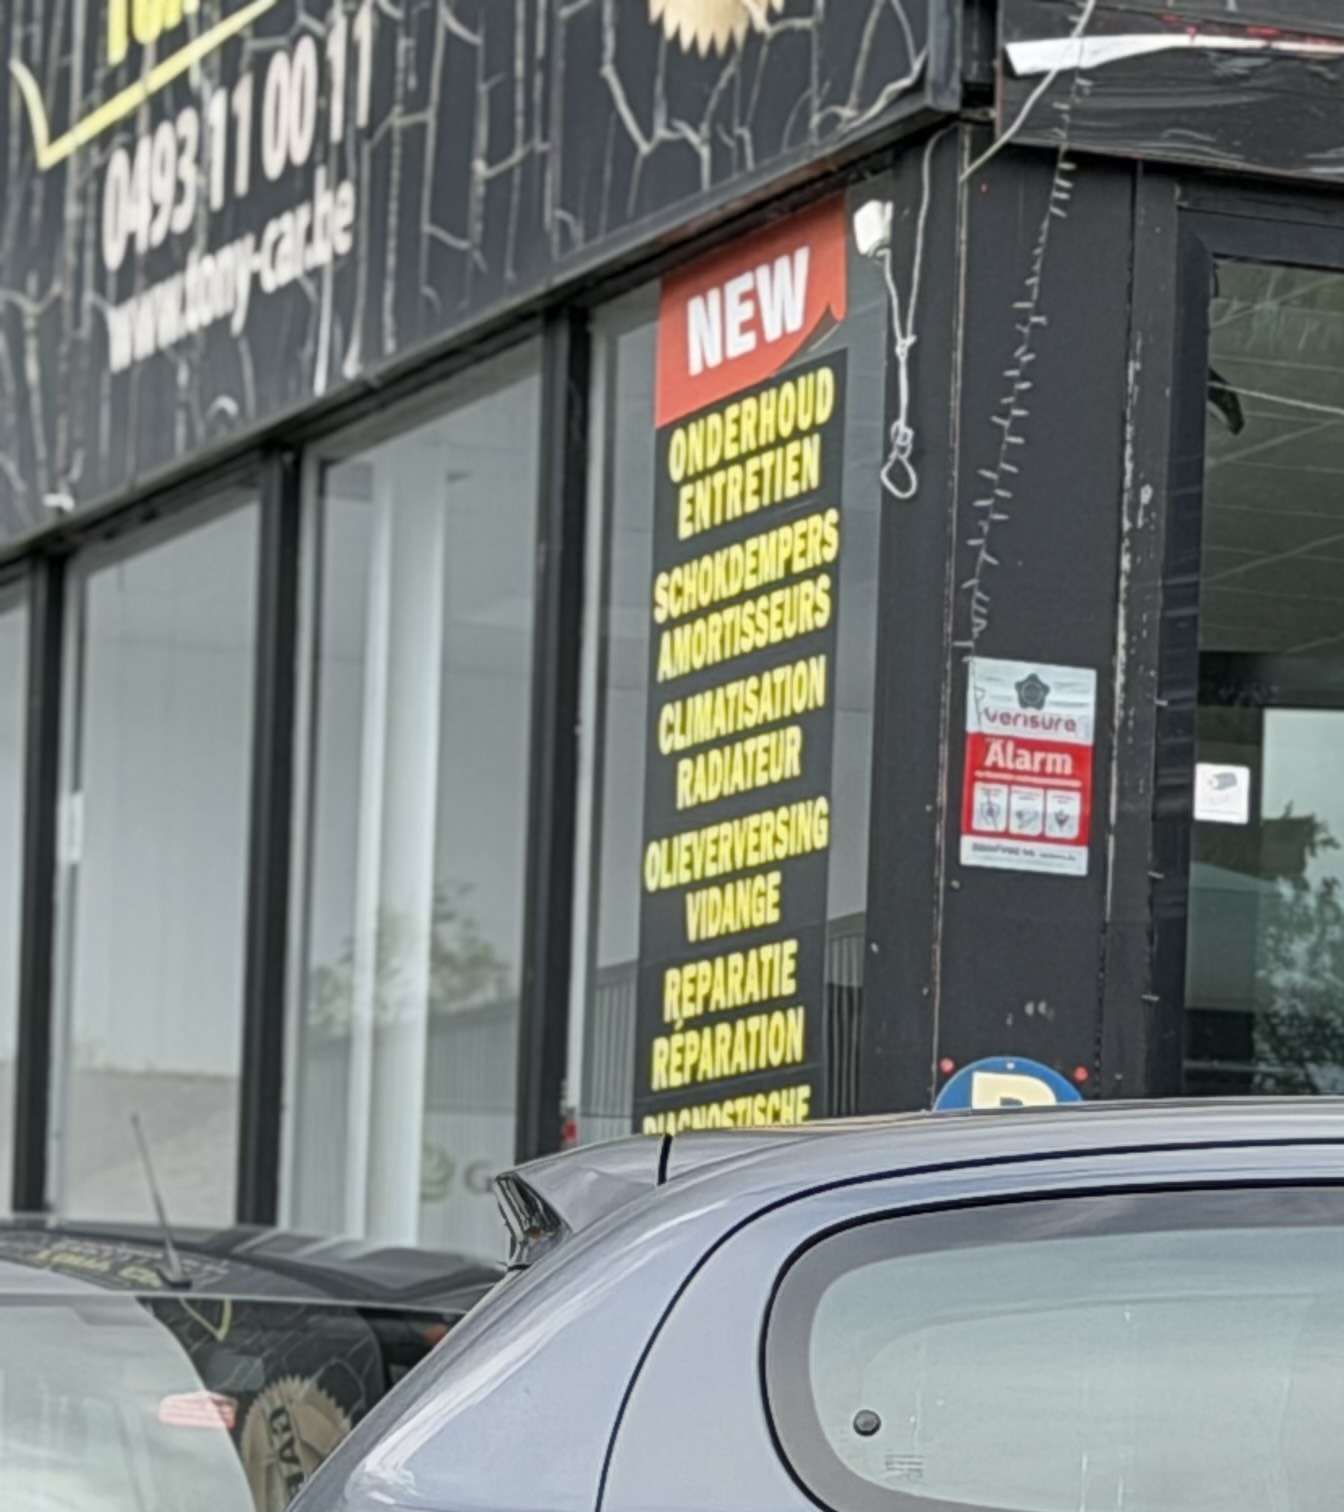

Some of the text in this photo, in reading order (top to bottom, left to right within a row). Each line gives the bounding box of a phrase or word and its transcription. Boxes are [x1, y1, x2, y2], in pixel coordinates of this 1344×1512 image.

[102, 105, 200, 272] 0493
[207, 72, 253, 212] 11
[262, 36, 319, 181] 00
[326, 0, 374, 145] 11
[686, 246, 811, 377] NEW
[668, 366, 835, 484] ONDERHOUD
[678, 433, 821, 542] ENTRETIEN
[653, 507, 840, 625] SCHOKDEMPERS
[656, 573, 832, 683] AMORTISSEURS
[658, 654, 827, 756] CLIMATISATION
[983, 706, 1078, 734] verisure
[676, 724, 802, 811] RADIATEUR
[983, 738, 1075, 776] Alarm
[644, 795, 830, 893] OLIEVERVERSING
[685, 870, 782, 943] VIDANGE
[663, 938, 799, 1024] REPARATIE
[651, 1005, 806, 1093] RÉPARATION
